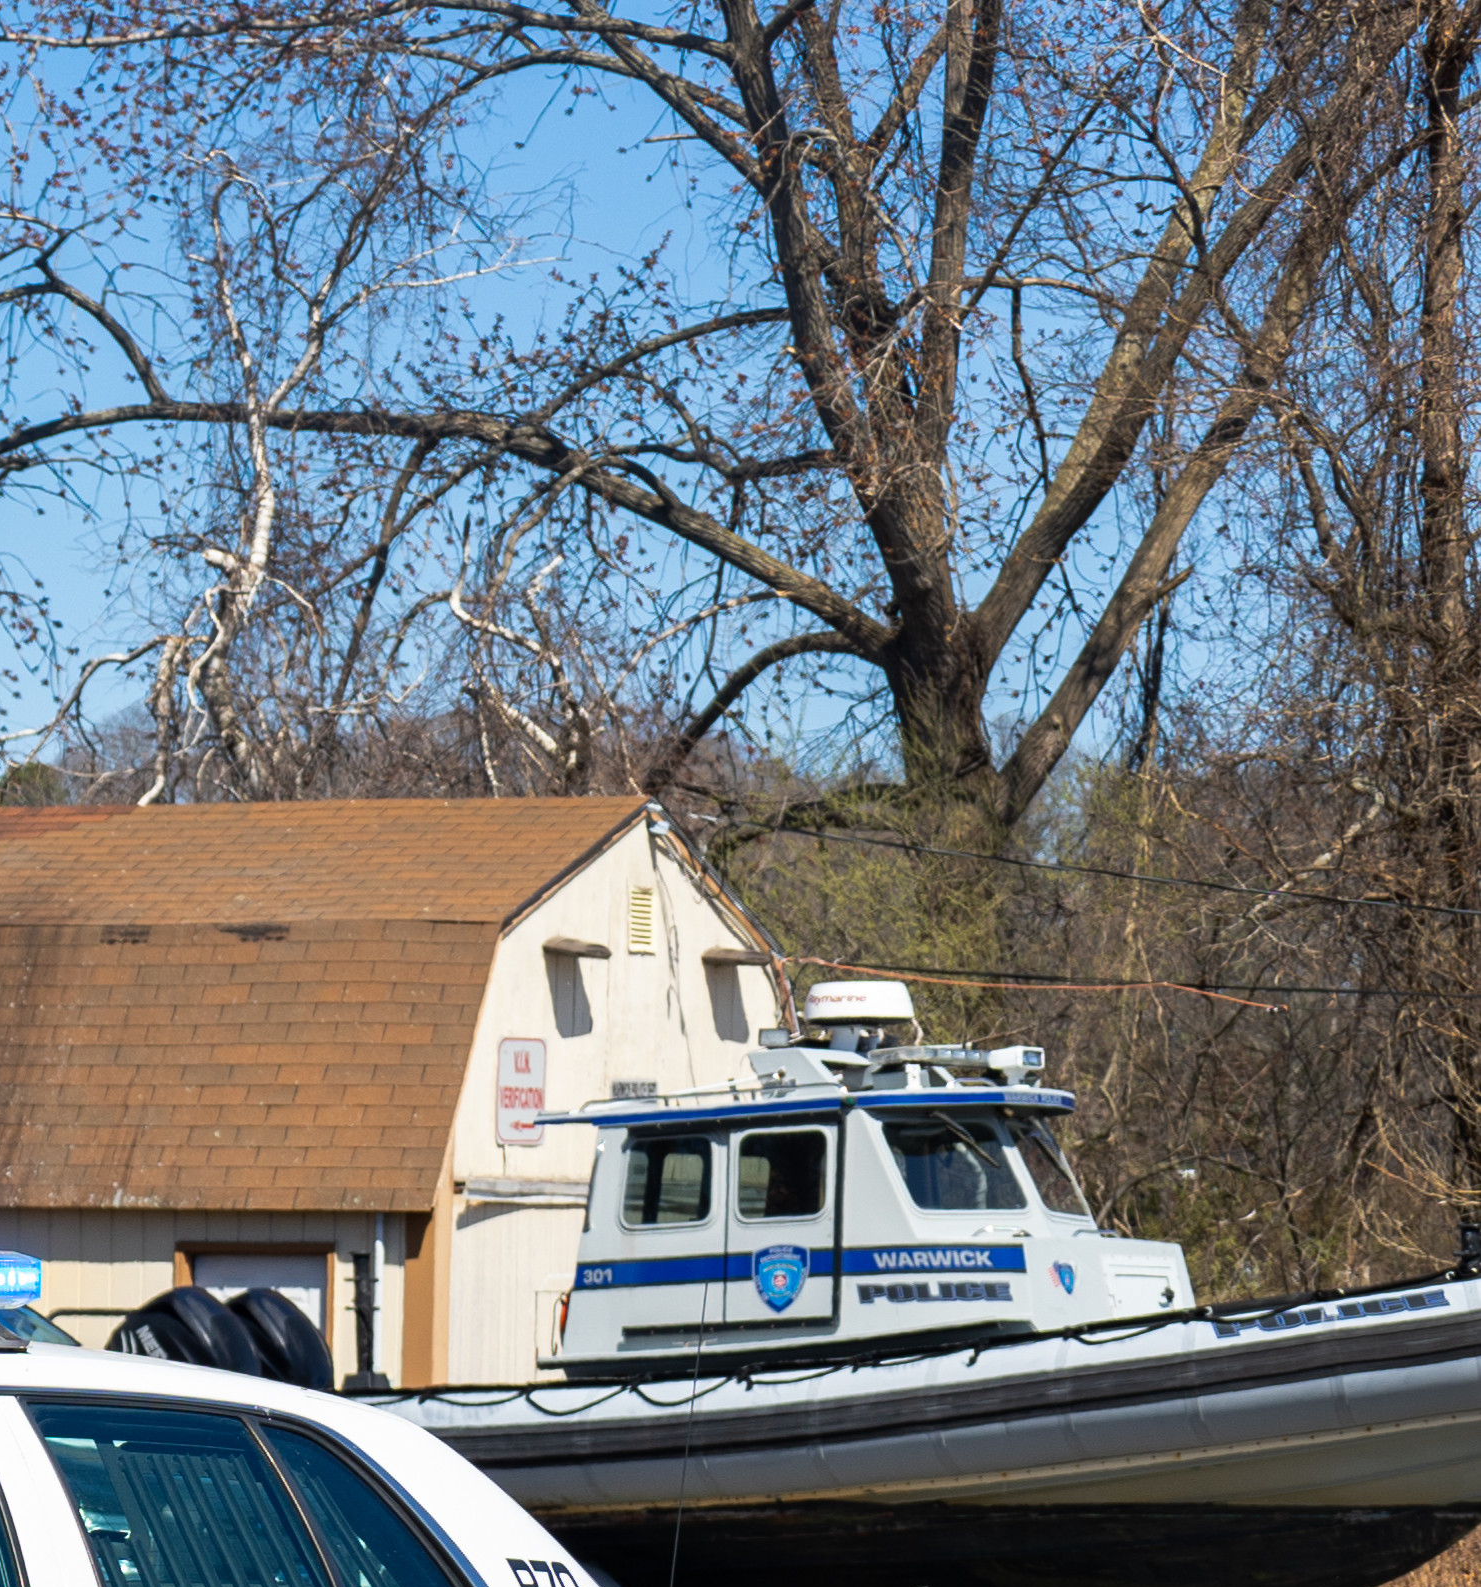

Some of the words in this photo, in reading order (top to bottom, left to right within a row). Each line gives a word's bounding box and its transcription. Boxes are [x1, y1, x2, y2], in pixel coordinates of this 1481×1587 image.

[500, 1086, 544, 1109] VERIFICATION
[873, 1250, 994, 1269] WARWICK
[583, 1268, 613, 1285] 301
[856, 1280, 1014, 1305] POLICE
